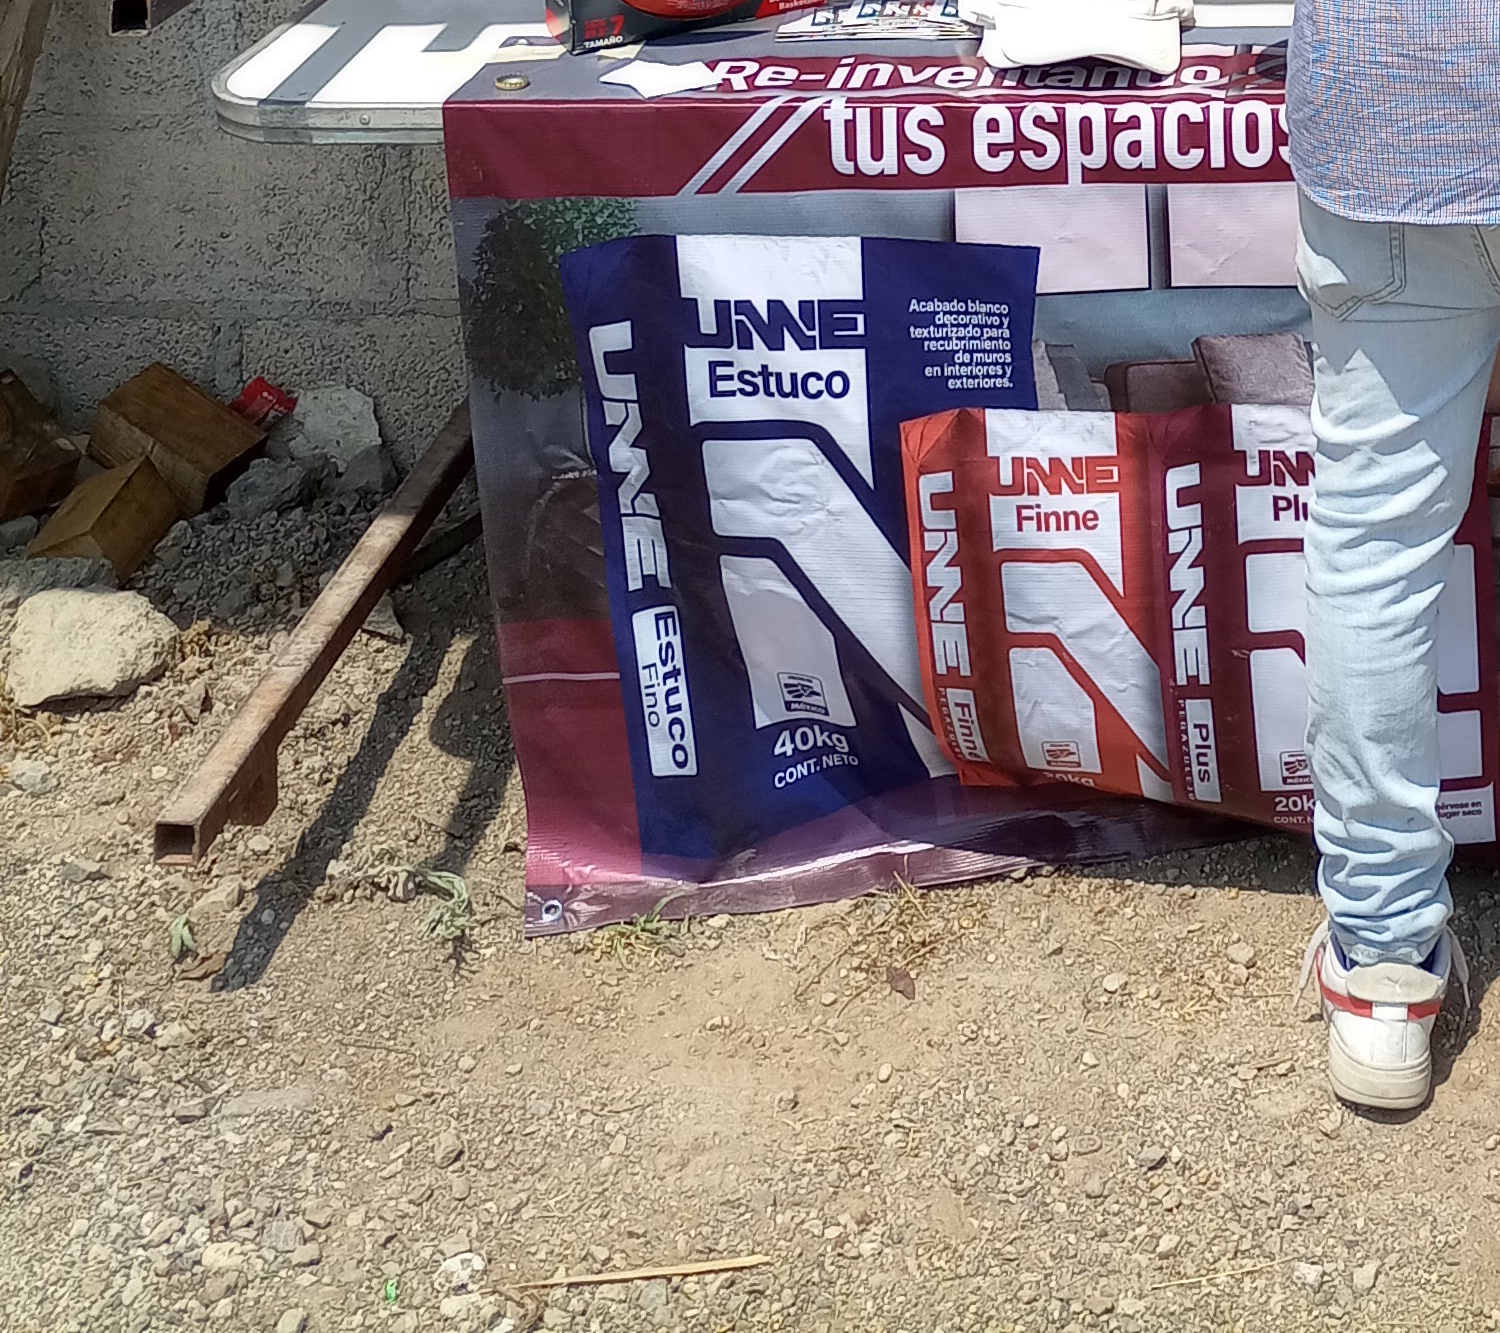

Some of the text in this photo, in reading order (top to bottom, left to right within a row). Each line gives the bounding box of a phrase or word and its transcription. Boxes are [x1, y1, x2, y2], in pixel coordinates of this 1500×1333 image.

[583, 35, 624, 49] TAMAÑO
[824, 96, 946, 177] tus
[909, 298, 1009, 315] Acabado blanco
[935, 312, 1010, 329] decorativo y
[909, 325, 1011, 340] texturizado para
[923, 337, 1012, 351] recubrimiento
[954, 350, 1012, 364] de muros
[924, 362, 1013, 378] en interiores y
[708, 359, 851, 401] Estuco
[947, 376, 1014, 390] exteriores.
[1015, 504, 1100, 533] Finne
[641, 662, 661, 728] Fino
[654, 610, 690, 770] Estuco
[773, 724, 850, 758] 40kg
[1192, 722, 1212, 784] Plus
[774, 752, 859, 789] CONT. NETO
[1274, 795, 1316, 813] 20k
[1273, 815, 1306, 825] CONT.
[1461, 809, 1483, 817] seco
